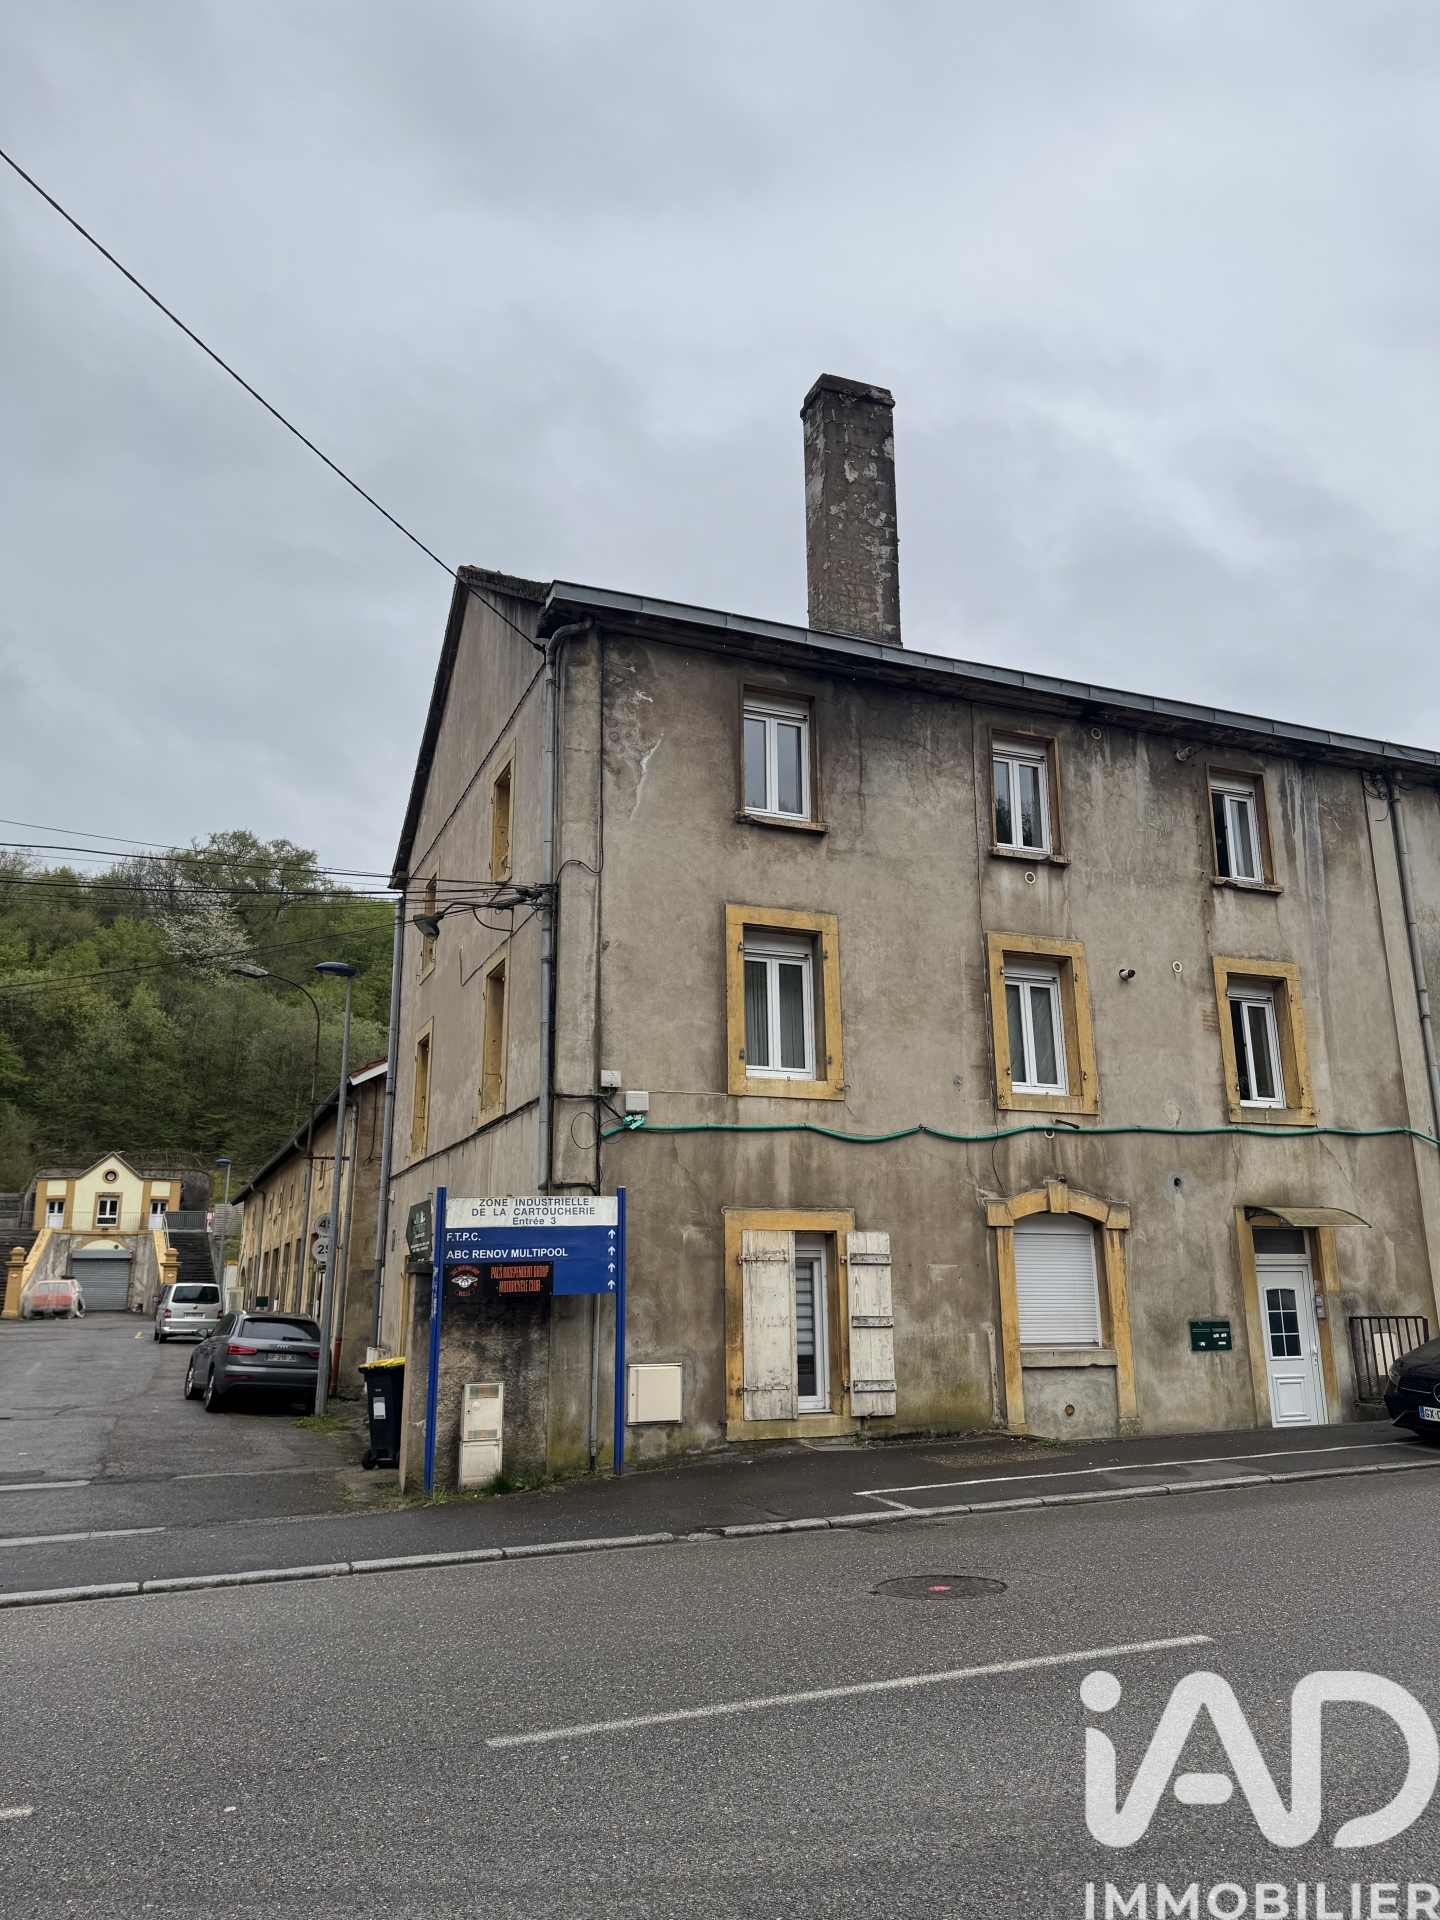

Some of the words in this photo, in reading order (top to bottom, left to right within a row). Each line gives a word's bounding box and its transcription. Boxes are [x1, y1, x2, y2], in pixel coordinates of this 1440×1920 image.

[479, 1198, 508, 1207] ZONE
[515, 1197, 589, 1207] INDUSTRIELLE
[471, 1208, 486, 1217] DE
[493, 1208, 507, 1216] LA
[513, 1207, 596, 1216] CARTOUCHERIE
[512, 1217, 545, 1226] Entrée
[550, 1217, 557, 1225] 3
[446, 1232, 481, 1242] F.T.P.C.
[446, 1250, 469, 1259] ABC
[472, 1249, 509, 1259] RENOV
[511, 1248, 568, 1258] MULTIPOOL
[499, 1280, 528, 1293] MOTORCYCLE
[529, 1279, 541, 1292] CLUB
